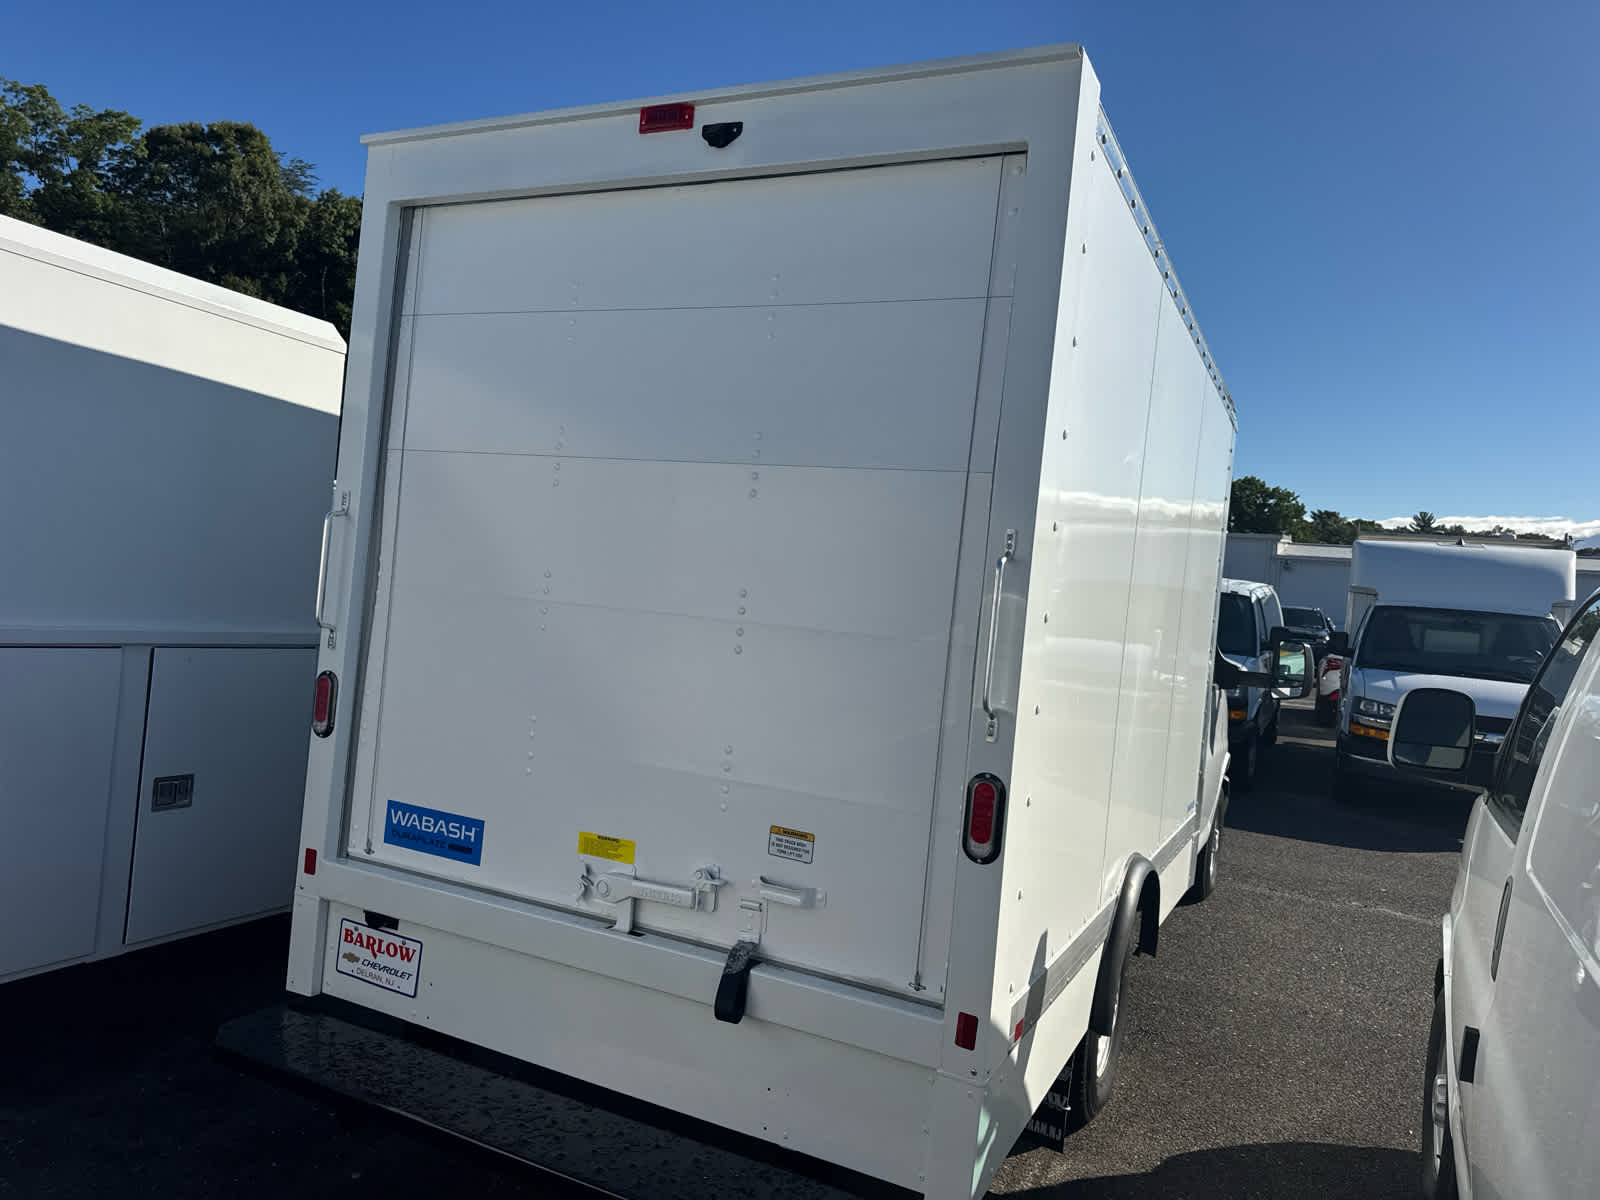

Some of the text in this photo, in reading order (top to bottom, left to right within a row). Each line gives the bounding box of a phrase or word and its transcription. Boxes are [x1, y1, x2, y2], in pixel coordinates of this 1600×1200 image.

[391, 808, 475, 842] WABASH
[344, 928, 416, 963] BARLOW
[356, 967, 394, 986] DELRAN, NJ
[362, 959, 413, 980] CHEVROLET
